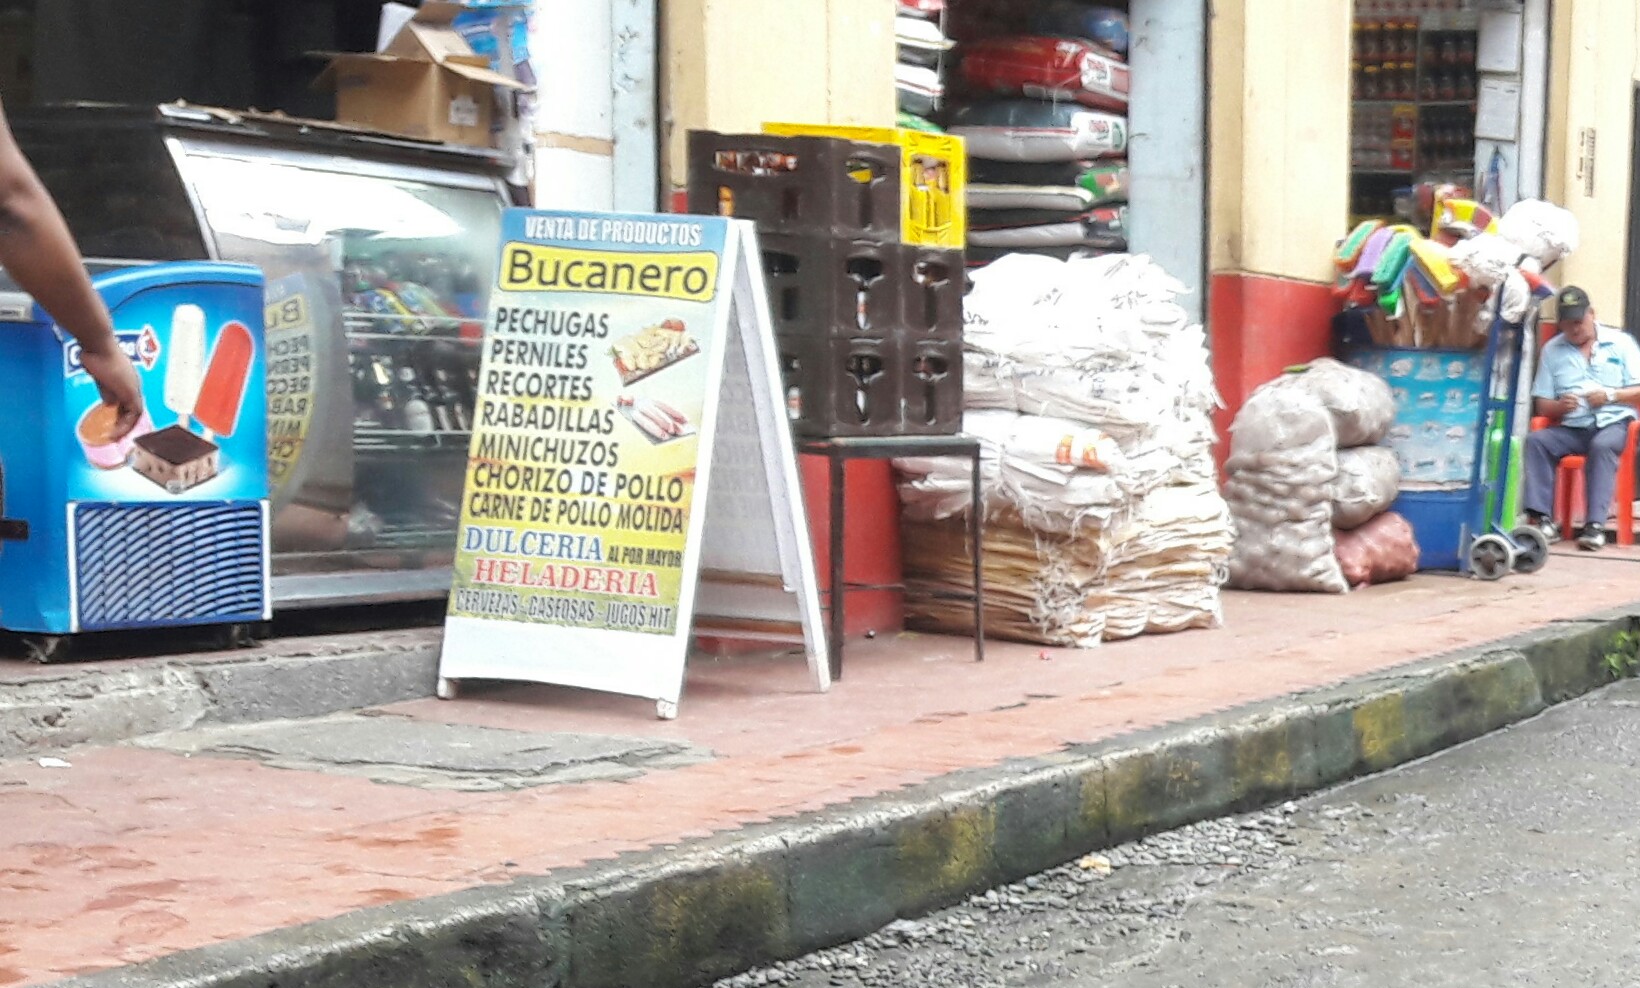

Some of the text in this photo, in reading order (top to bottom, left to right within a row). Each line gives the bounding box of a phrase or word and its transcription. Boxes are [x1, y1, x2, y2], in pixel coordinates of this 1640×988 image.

[525, 216, 701, 246] VENTA DE PRODUCTOS
[507, 249, 708, 294] Bucanero
[494, 306, 610, 338] PECHUGAS
[490, 339, 589, 369] PERNILES
[486, 370, 593, 401] RECORTES
[481, 401, 615, 436] RABADILLAS
[477, 433, 619, 468] MINICHUZOS
[474, 463, 684, 503] CHORIZO DE POLLO
[469, 492, 684, 534] CARNE DE POLLO MOLIDA
[463, 526, 682, 568] DULCERIA AL POR MAYOR
[472, 558, 659, 597] HELADERIA
[456, 588, 518, 616] CERVEZAS
[528, 595, 595, 622] GASEOSAS
[605, 601, 645, 628] JUGOS
[649, 606, 672, 629] HIT
